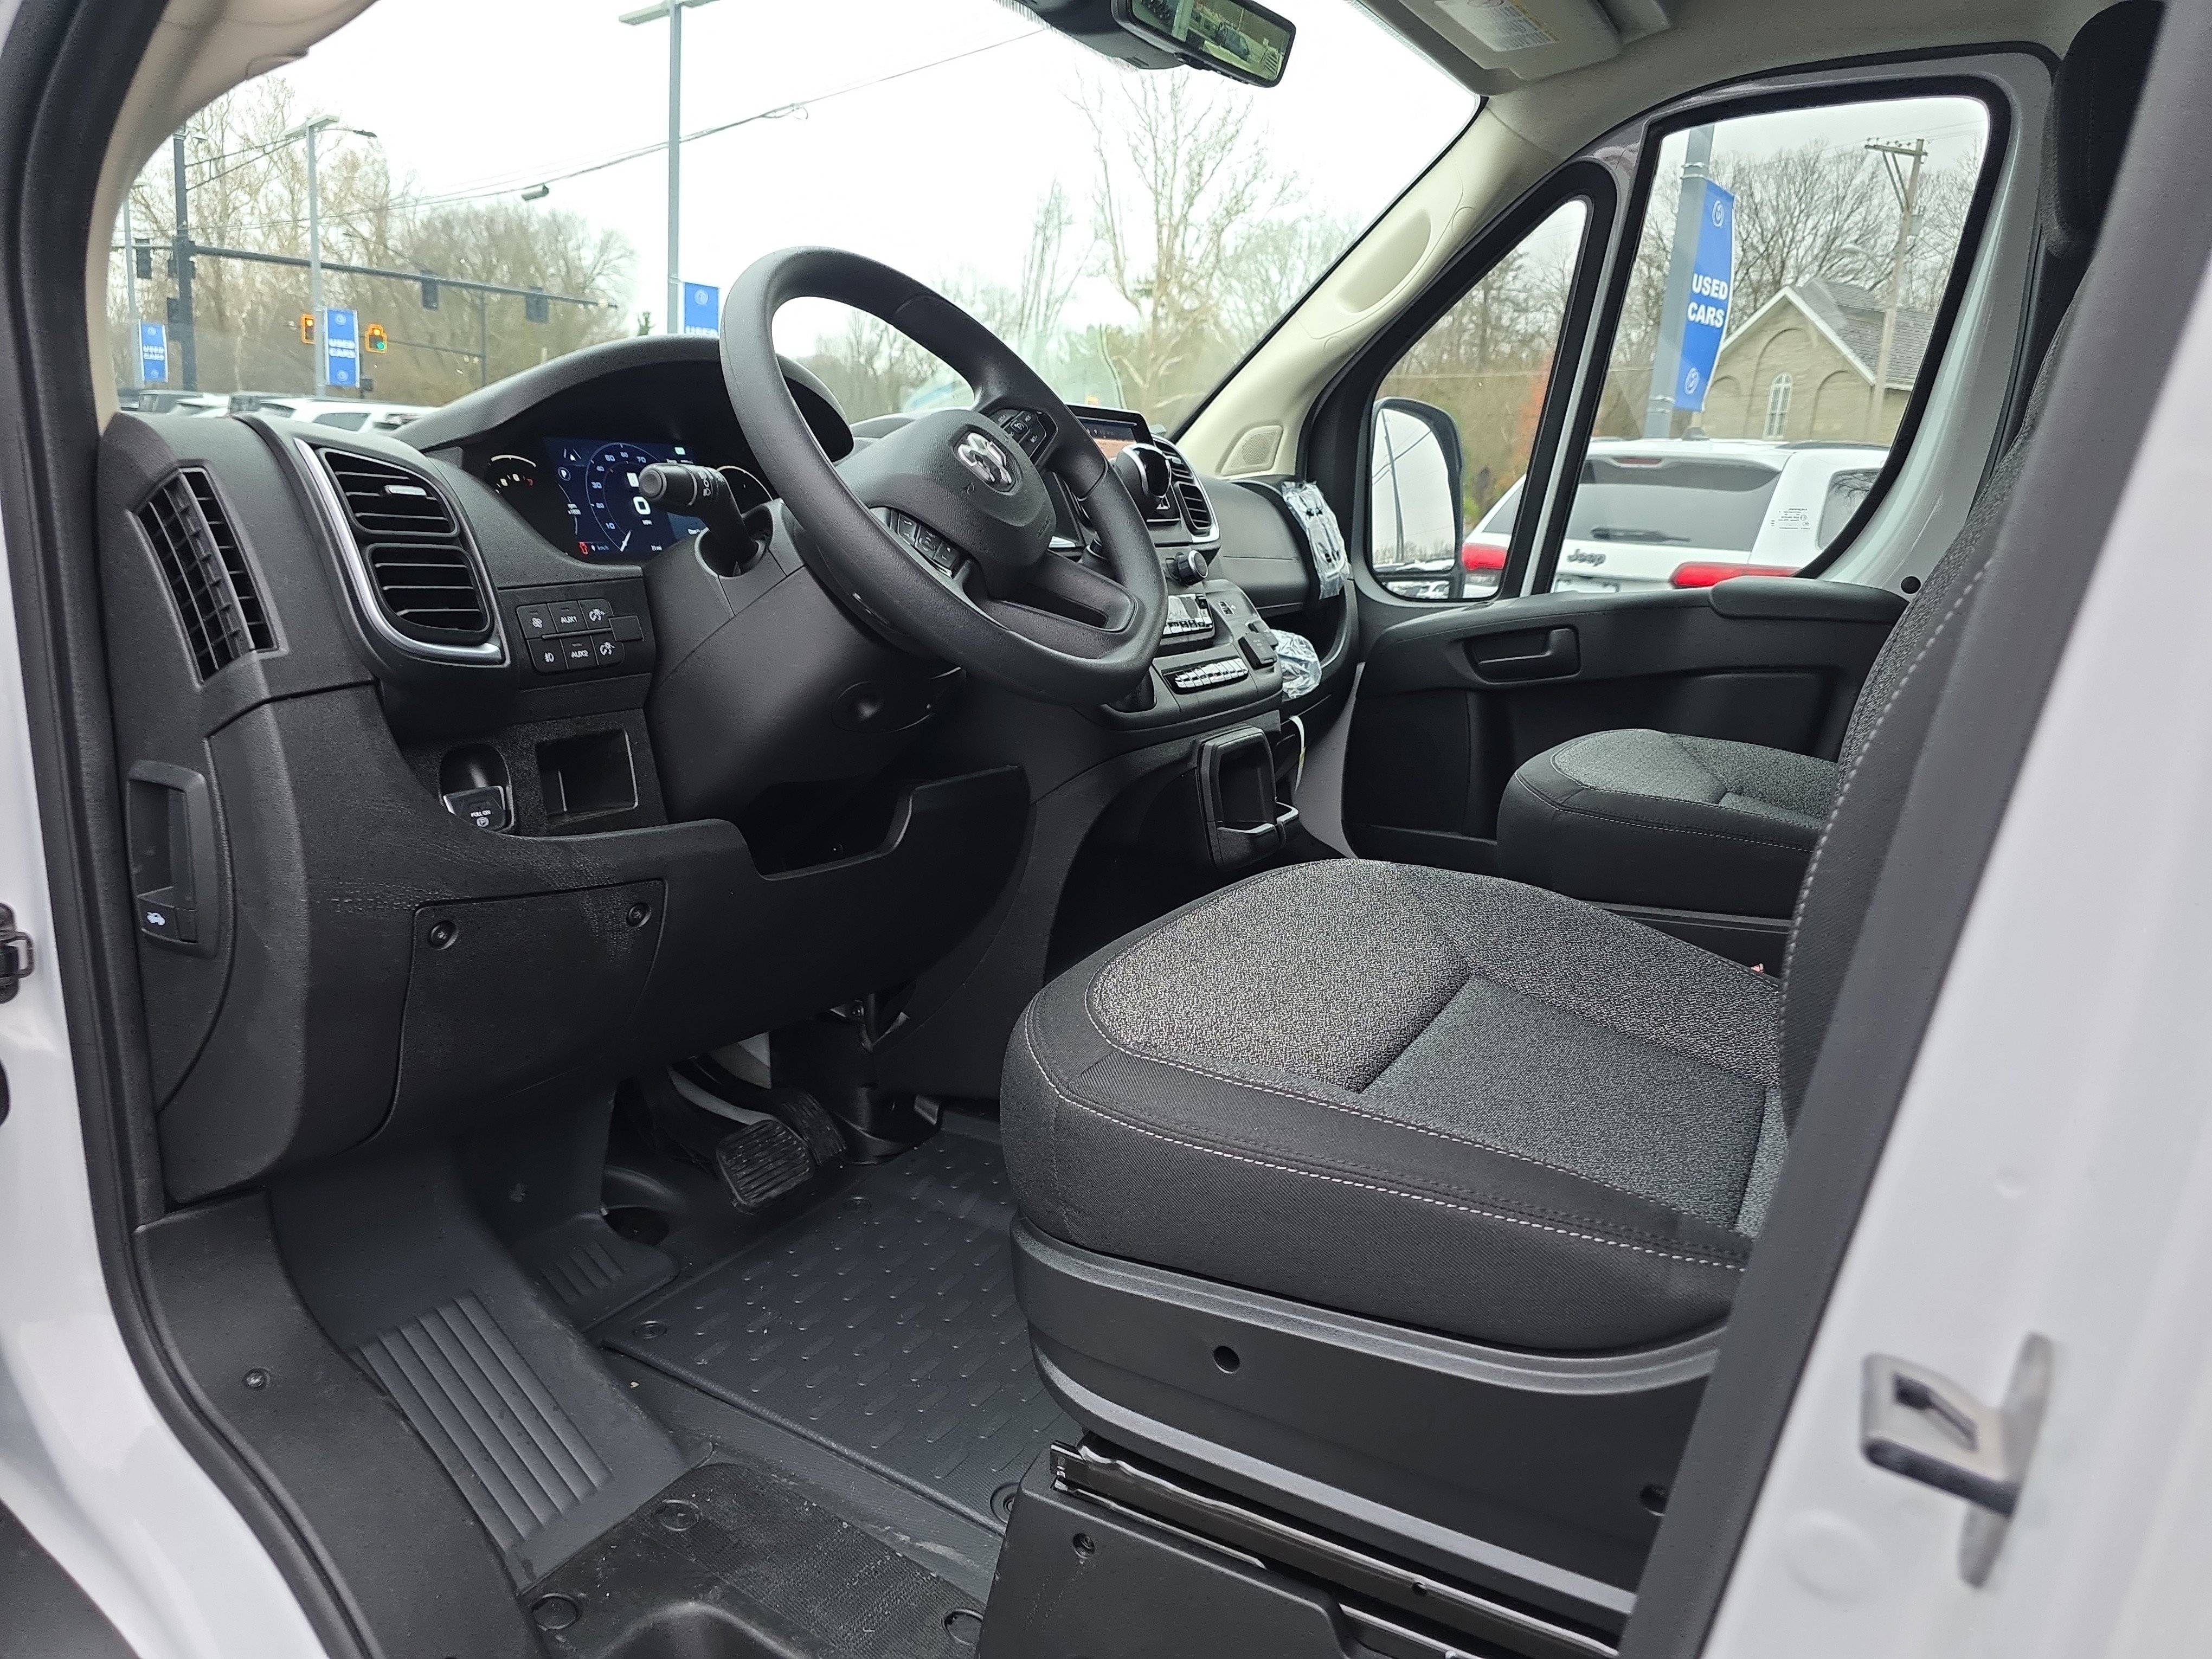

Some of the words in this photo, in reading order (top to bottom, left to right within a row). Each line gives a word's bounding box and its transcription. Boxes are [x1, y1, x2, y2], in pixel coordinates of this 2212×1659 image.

[1692, 273, 1728, 301] USED
[1688, 301, 1725, 328] CARS
[143, 345, 164, 354] USED
[328, 339, 355, 350] USED
[143, 352, 164, 361] CARS
[329, 349, 356, 358] CARS
[633, 496, 651, 515] 0
[1567, 549, 1606, 567] Jeep
[561, 615, 578, 623] AUX1
[571, 650, 589, 658] AUX2
